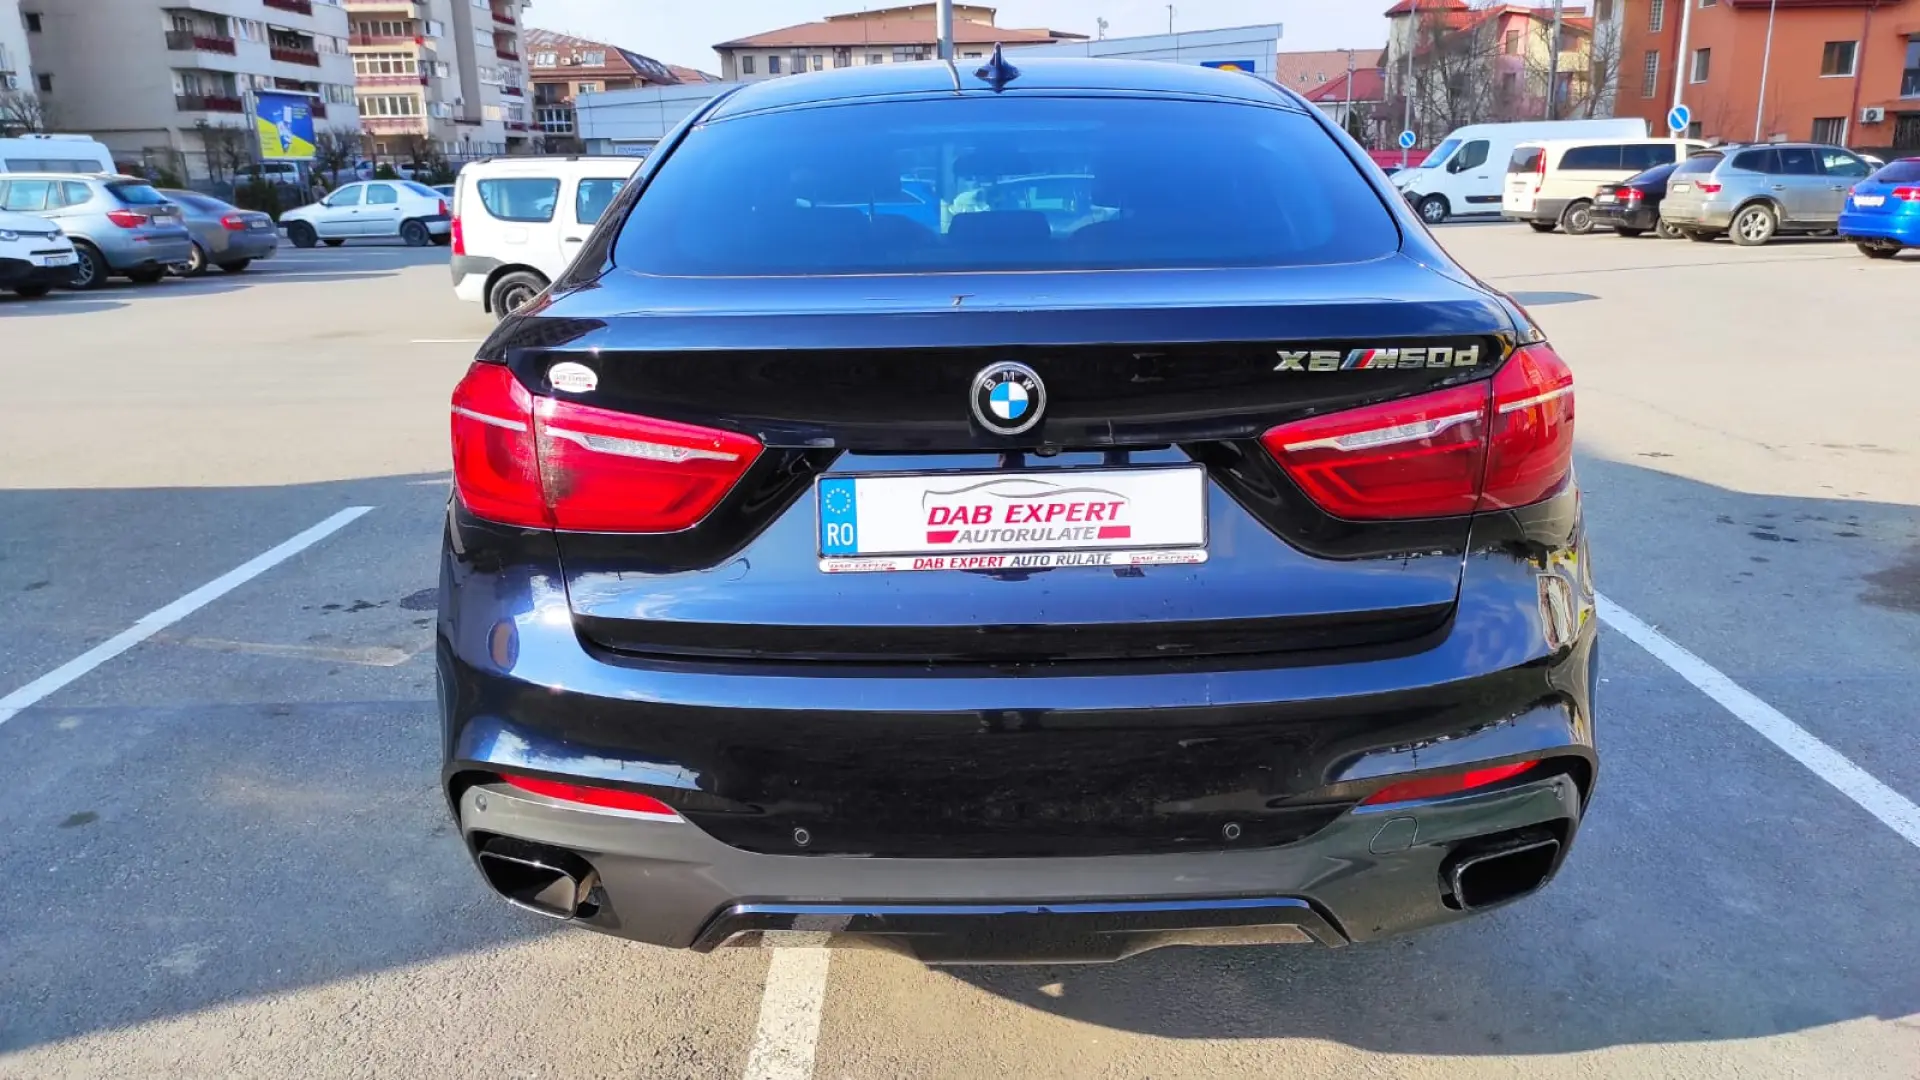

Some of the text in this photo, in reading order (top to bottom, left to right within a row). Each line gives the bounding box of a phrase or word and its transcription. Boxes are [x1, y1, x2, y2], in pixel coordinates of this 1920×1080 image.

[1273, 345, 1480, 372] X6 M50d
[983, 371, 1035, 391] BMW
[927, 501, 1125, 526] DAB EXPERT
[827, 522, 854, 546] RO
[957, 526, 1096, 544] AUTORULATE
[912, 553, 1112, 570] DAB EXPERT AUTO RULATE
